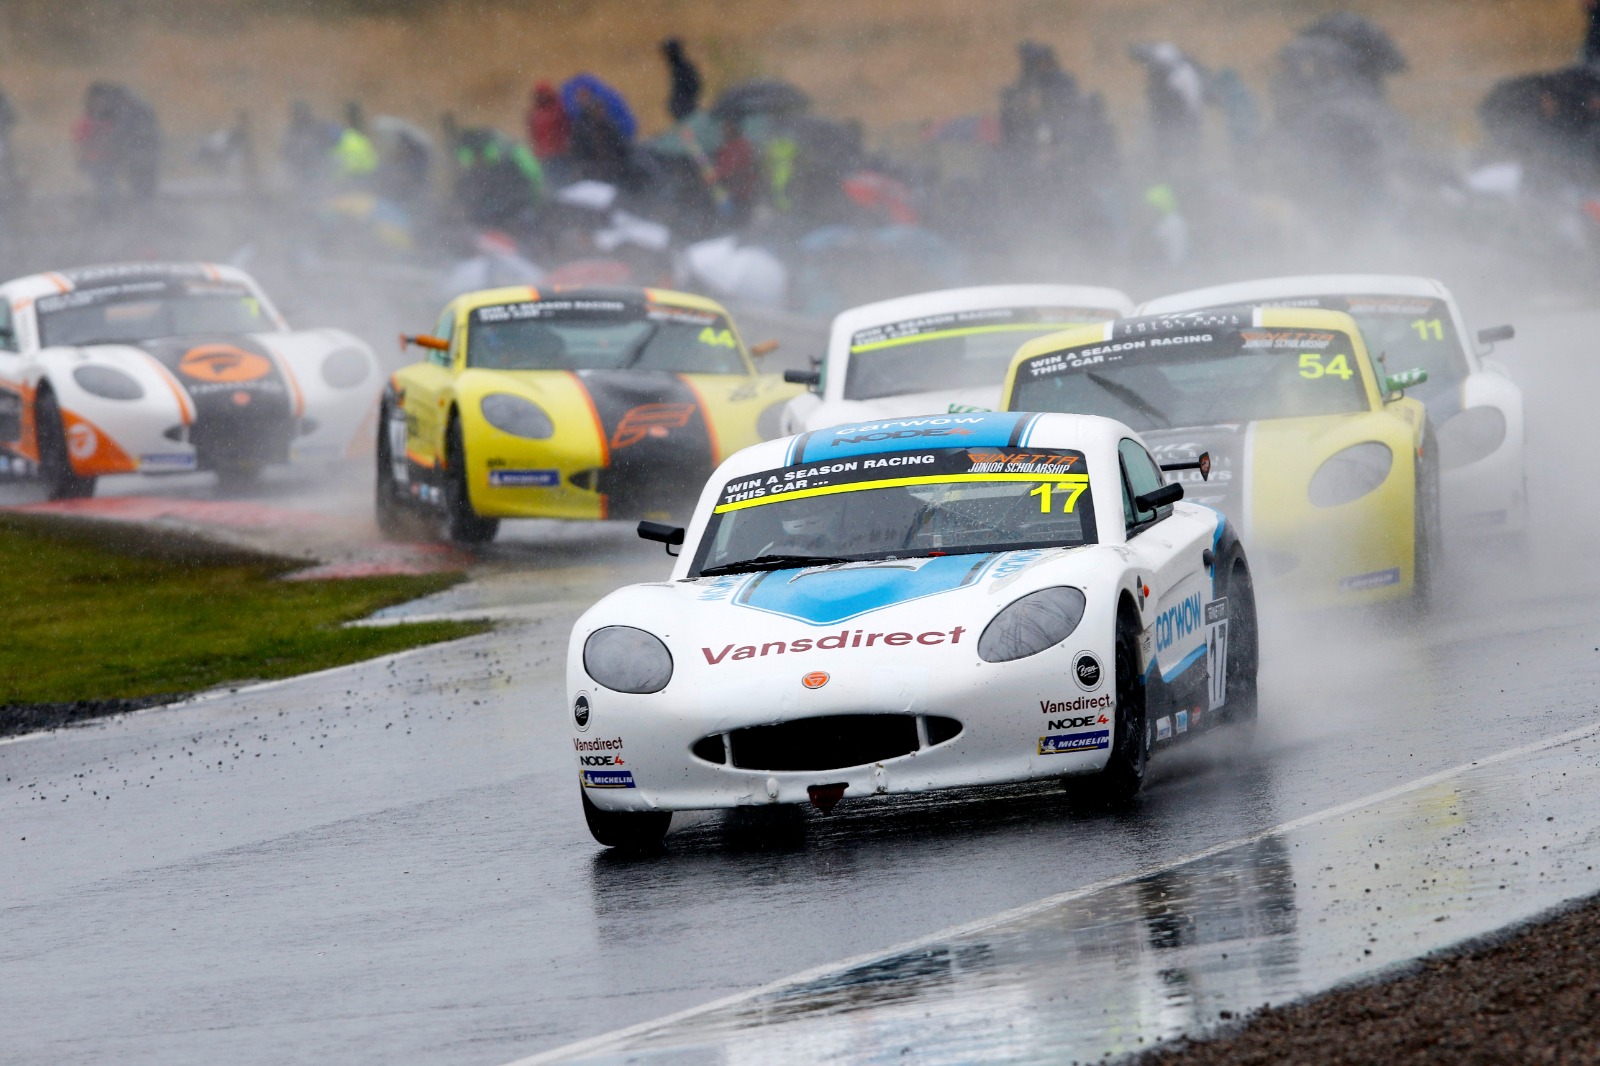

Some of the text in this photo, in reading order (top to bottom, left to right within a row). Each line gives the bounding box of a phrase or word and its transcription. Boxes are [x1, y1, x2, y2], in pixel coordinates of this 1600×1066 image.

[698, 327, 736, 349] 44
[1411, 319, 1444, 341] 11
[1030, 334, 1213, 369] WIN A SEASON RACING
[1030, 362, 1067, 377] THIS
[1071, 356, 1105, 368] CAR
[1298, 353, 1354, 380] 54
[836, 417, 985, 435] carwow
[967, 453, 1080, 466] GINETTA
[967, 462, 1071, 474] JUNIOR SCHOLARSHIP
[726, 455, 935, 494] WIN A SEASON RACING
[724, 487, 766, 504] THIS
[770, 479, 808, 494] CAR
[1030, 482, 1088, 514] 17
[1156, 591, 1202, 653] carwow
[701, 626, 967, 665] Vansdirect
[1209, 622, 1227, 702] 17
[1040, 694, 1111, 714] Vansdirect
[573, 736, 623, 751] Vansdirect
[1058, 736, 1109, 748] MICHELIN
[594, 776, 633, 784] MICHELIN
